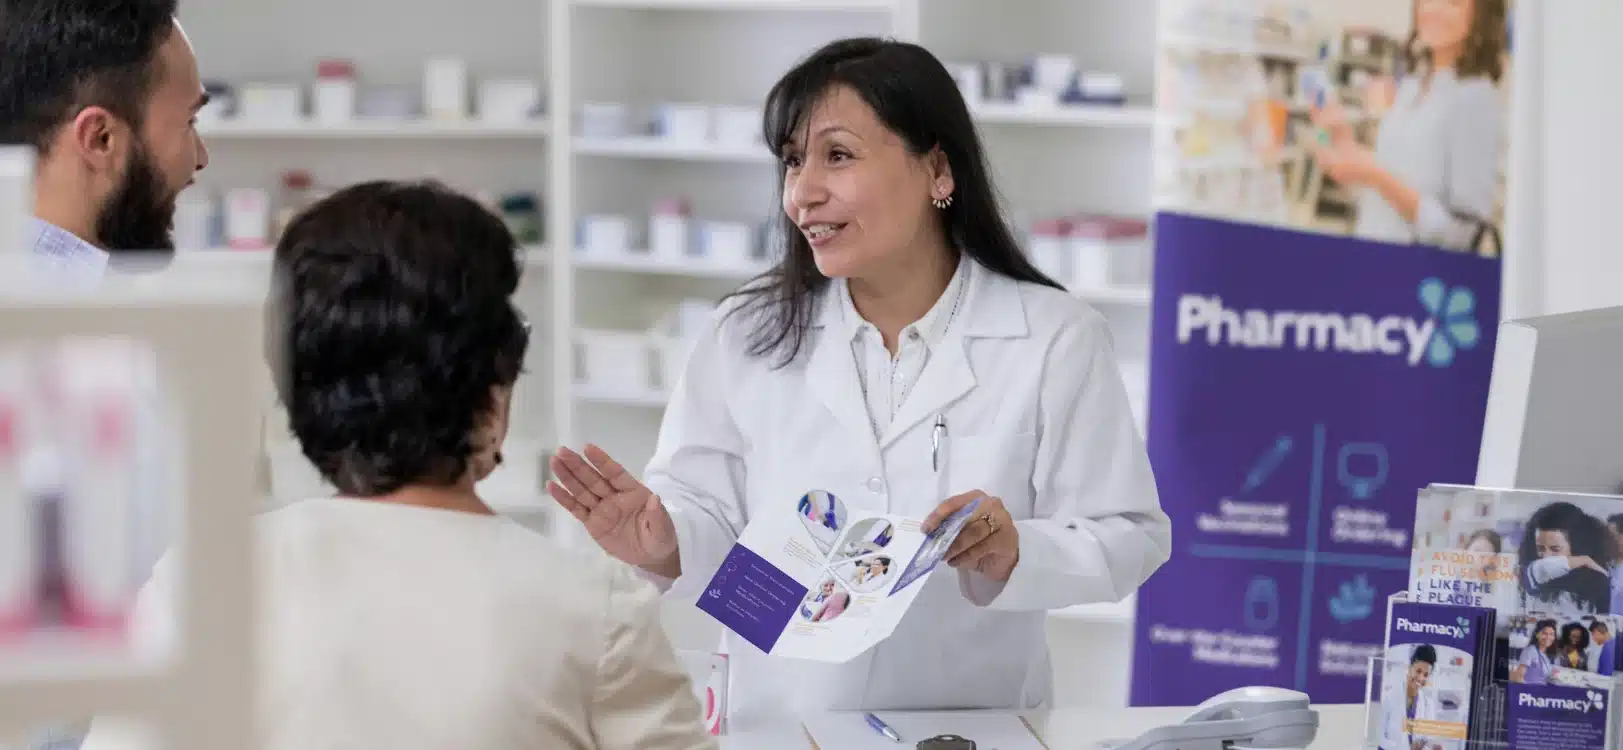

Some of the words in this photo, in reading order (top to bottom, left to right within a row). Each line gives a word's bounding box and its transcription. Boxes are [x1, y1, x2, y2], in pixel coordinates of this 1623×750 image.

[1177, 293, 1433, 366] Pharmacy
[1432, 552, 1474, 564] AVOID
[1432, 565, 1456, 577] FLU
[1430, 578, 1460, 592] LIKE
[1465, 581, 1492, 594] THE
[1428, 592, 1482, 606] PLAGUE
[1396, 617, 1460, 638] Pharmacy
[1518, 692, 1592, 714] Pharmacy
